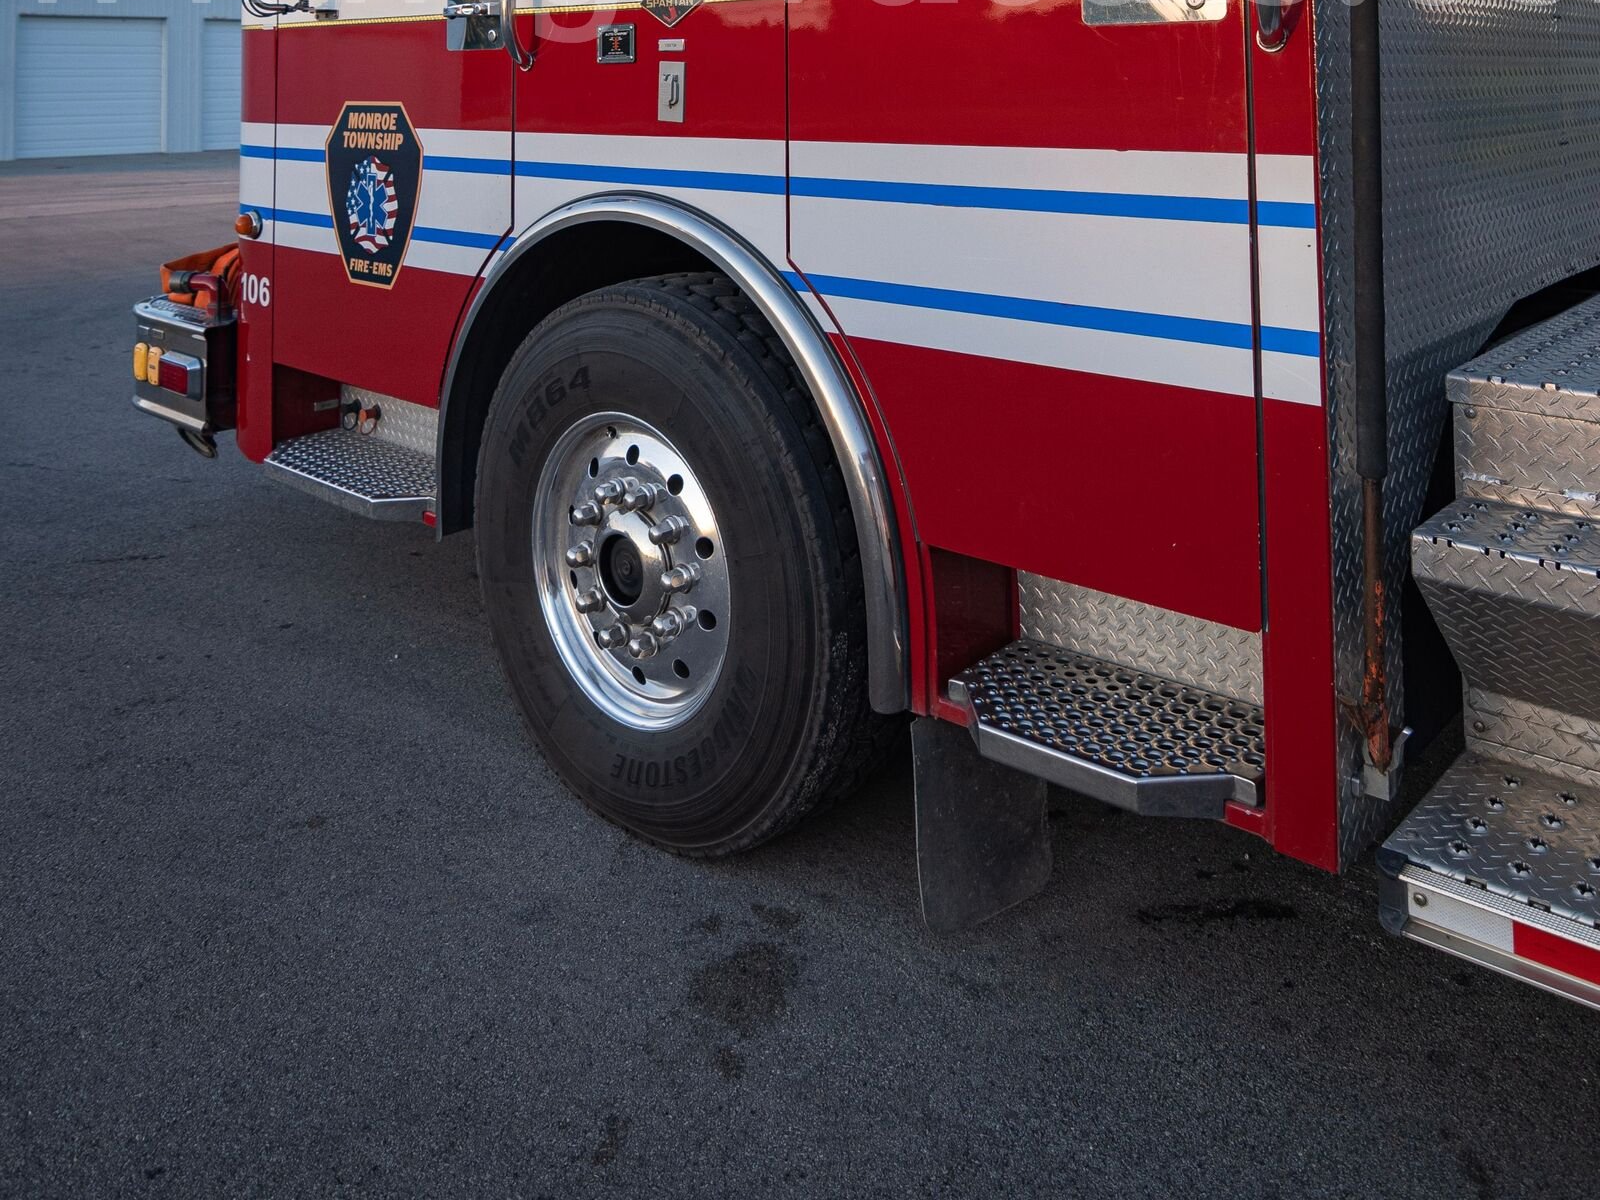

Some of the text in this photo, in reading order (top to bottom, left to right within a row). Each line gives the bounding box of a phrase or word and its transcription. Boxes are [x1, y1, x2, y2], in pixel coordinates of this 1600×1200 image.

[348, 112, 398, 130] MONROE
[343, 131, 404, 151] TOWNSHIP
[349, 258, 393, 277] FIRE-EMS
[241, 272, 271, 307] 106
